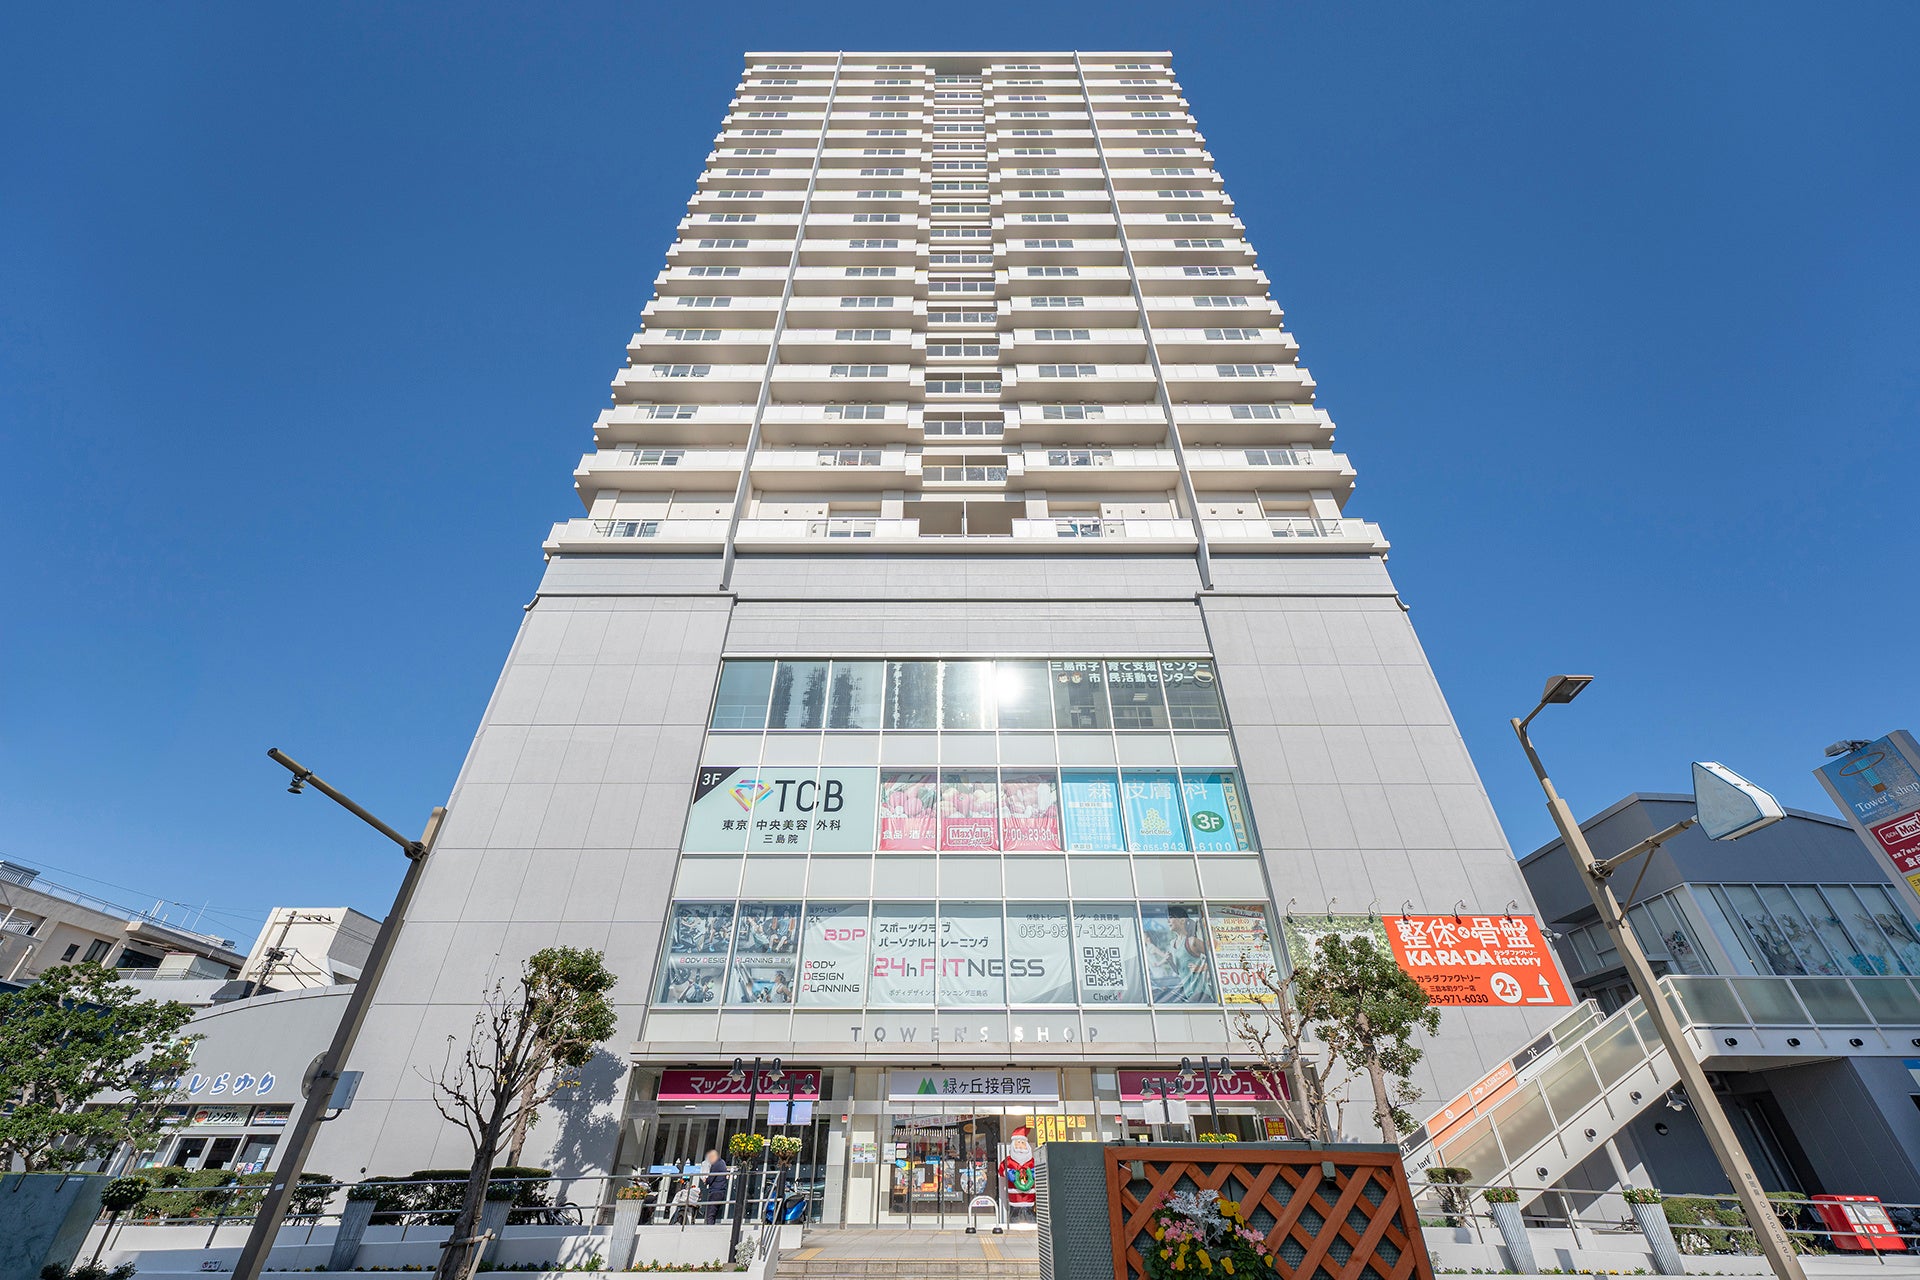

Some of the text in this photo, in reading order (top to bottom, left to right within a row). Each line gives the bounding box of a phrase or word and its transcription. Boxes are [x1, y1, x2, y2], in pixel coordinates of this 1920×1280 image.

[1051, 661, 1209, 672] 三島市子育て支援センター
[1088, 672, 1194, 683] 市民活動センター
[702, 773, 722, 785] 3F
[1087, 778, 1208, 800] 森皮膚科
[774, 779, 844, 812] TCB
[1855, 791, 1894, 813] Tower's
[1895, 781, 1920, 795] shop
[721, 819, 841, 831] 東京中央美容外科
[1197, 814, 1220, 829] 3F
[763, 834, 799, 844] 三島院
[879, 921, 951, 933] スポーツクラブ
[824, 928, 866, 941] BDP
[878, 936, 989, 948] パーソナルトレーニング
[804, 960, 836, 969] BODY
[1495, 955, 1541, 967] factory
[803, 972, 845, 981] DESIGN
[1416, 974, 1481, 983] カラダファクトリー
[801, 984, 860, 993] PLANNING
[1495, 977, 1518, 997] 2F
[1427, 993, 1489, 1004] 55-971-6030
[1013, 1026, 1098, 1042] SHOP
[1527, 1047, 1539, 1060] 2F
